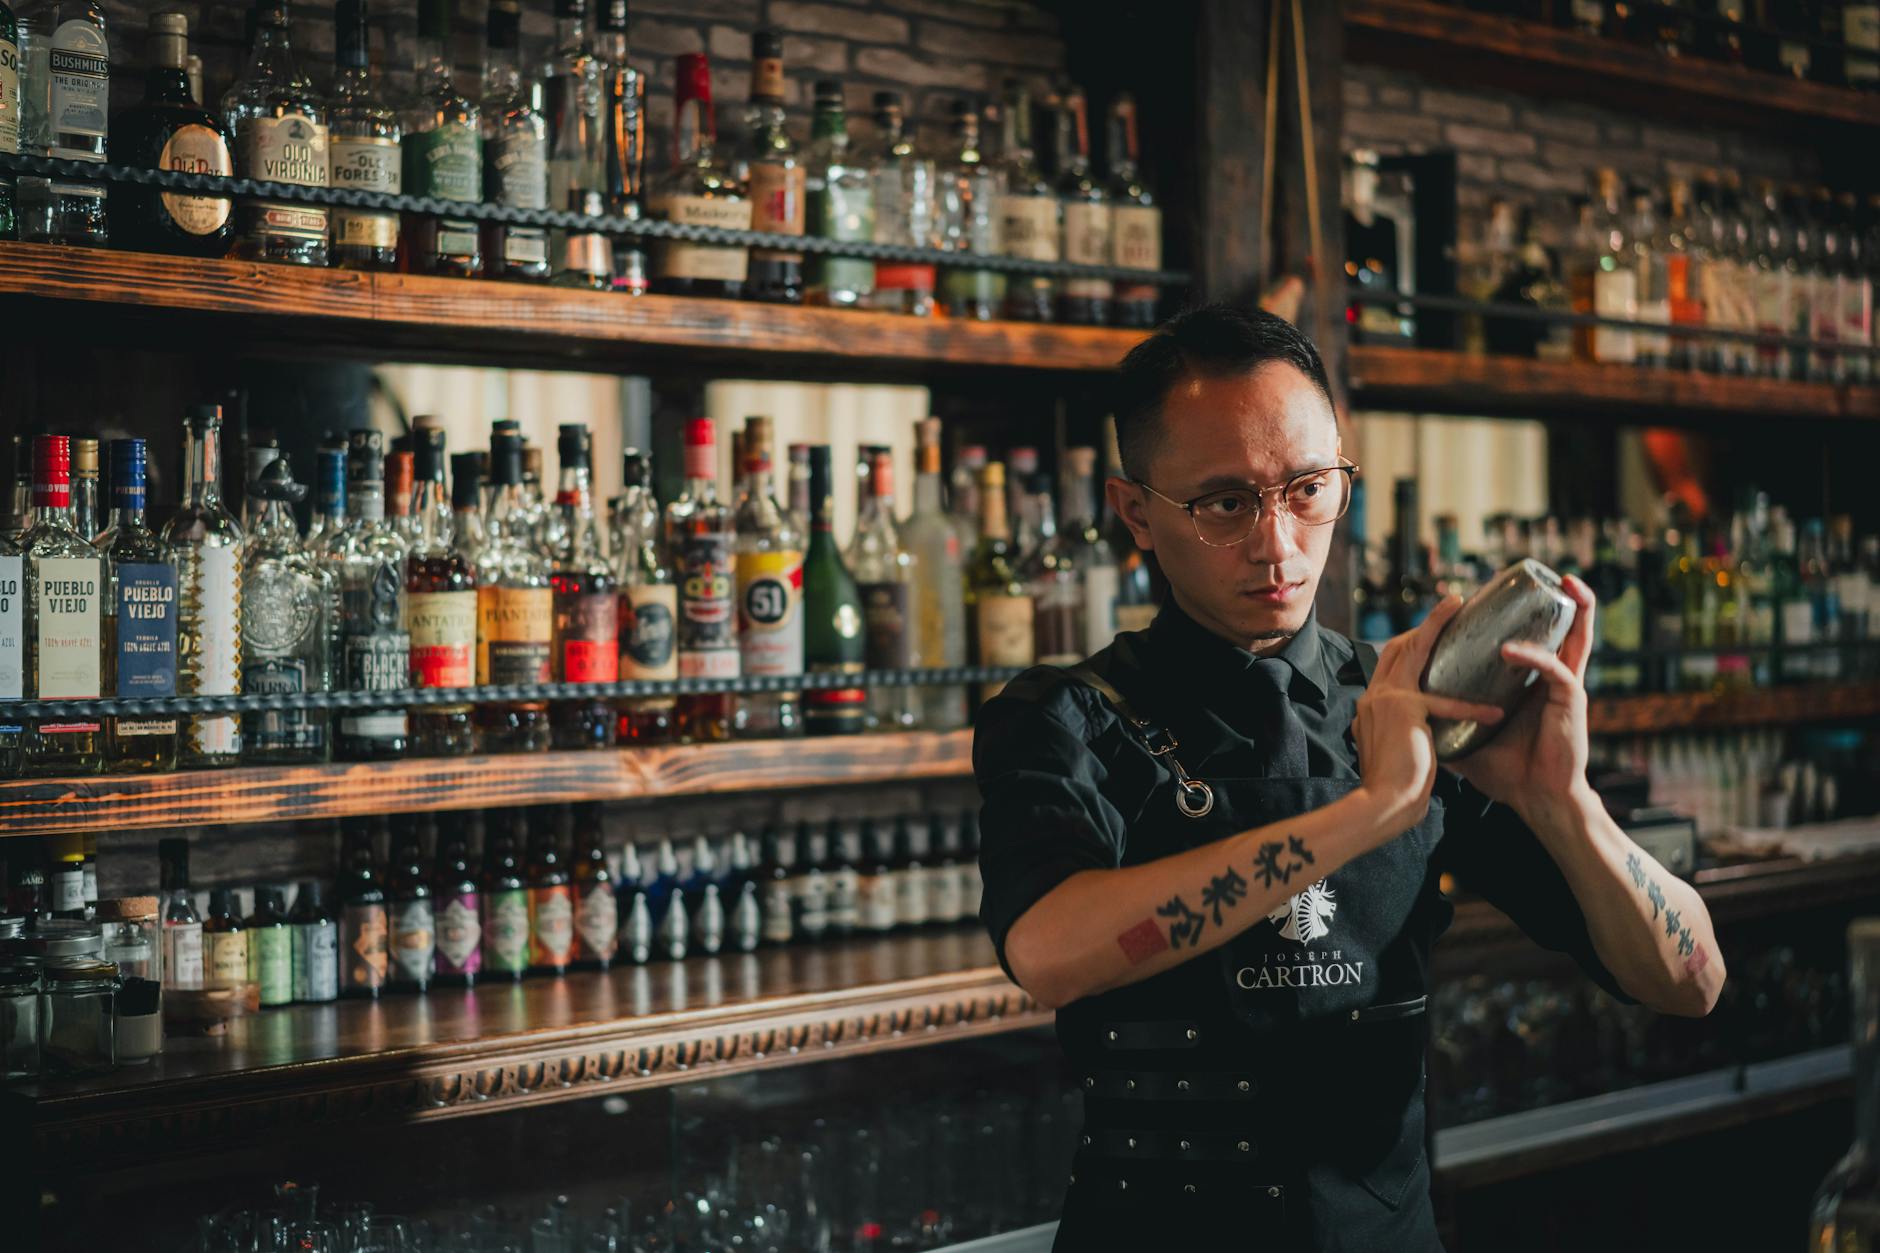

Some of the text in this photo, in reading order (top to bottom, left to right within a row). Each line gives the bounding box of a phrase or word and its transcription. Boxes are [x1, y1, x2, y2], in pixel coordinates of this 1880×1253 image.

[52, 54, 108, 74] BUSHMILLS
[55, 76, 69, 86] THE
[284, 143, 312, 164] OLD
[264, 159, 327, 183] VIRGINIA
[44, 581, 95, 596] PUEBLO
[124, 586, 173, 602] PUEBLO
[49, 598, 87, 613] VIEJO
[751, 585, 783, 618] 51
[128, 603, 166, 619] VIEJO
[363, 653, 404, 674] BLACK
[1264, 950, 1342, 963] JOSEPH
[1236, 961, 1364, 989] CARTRON
